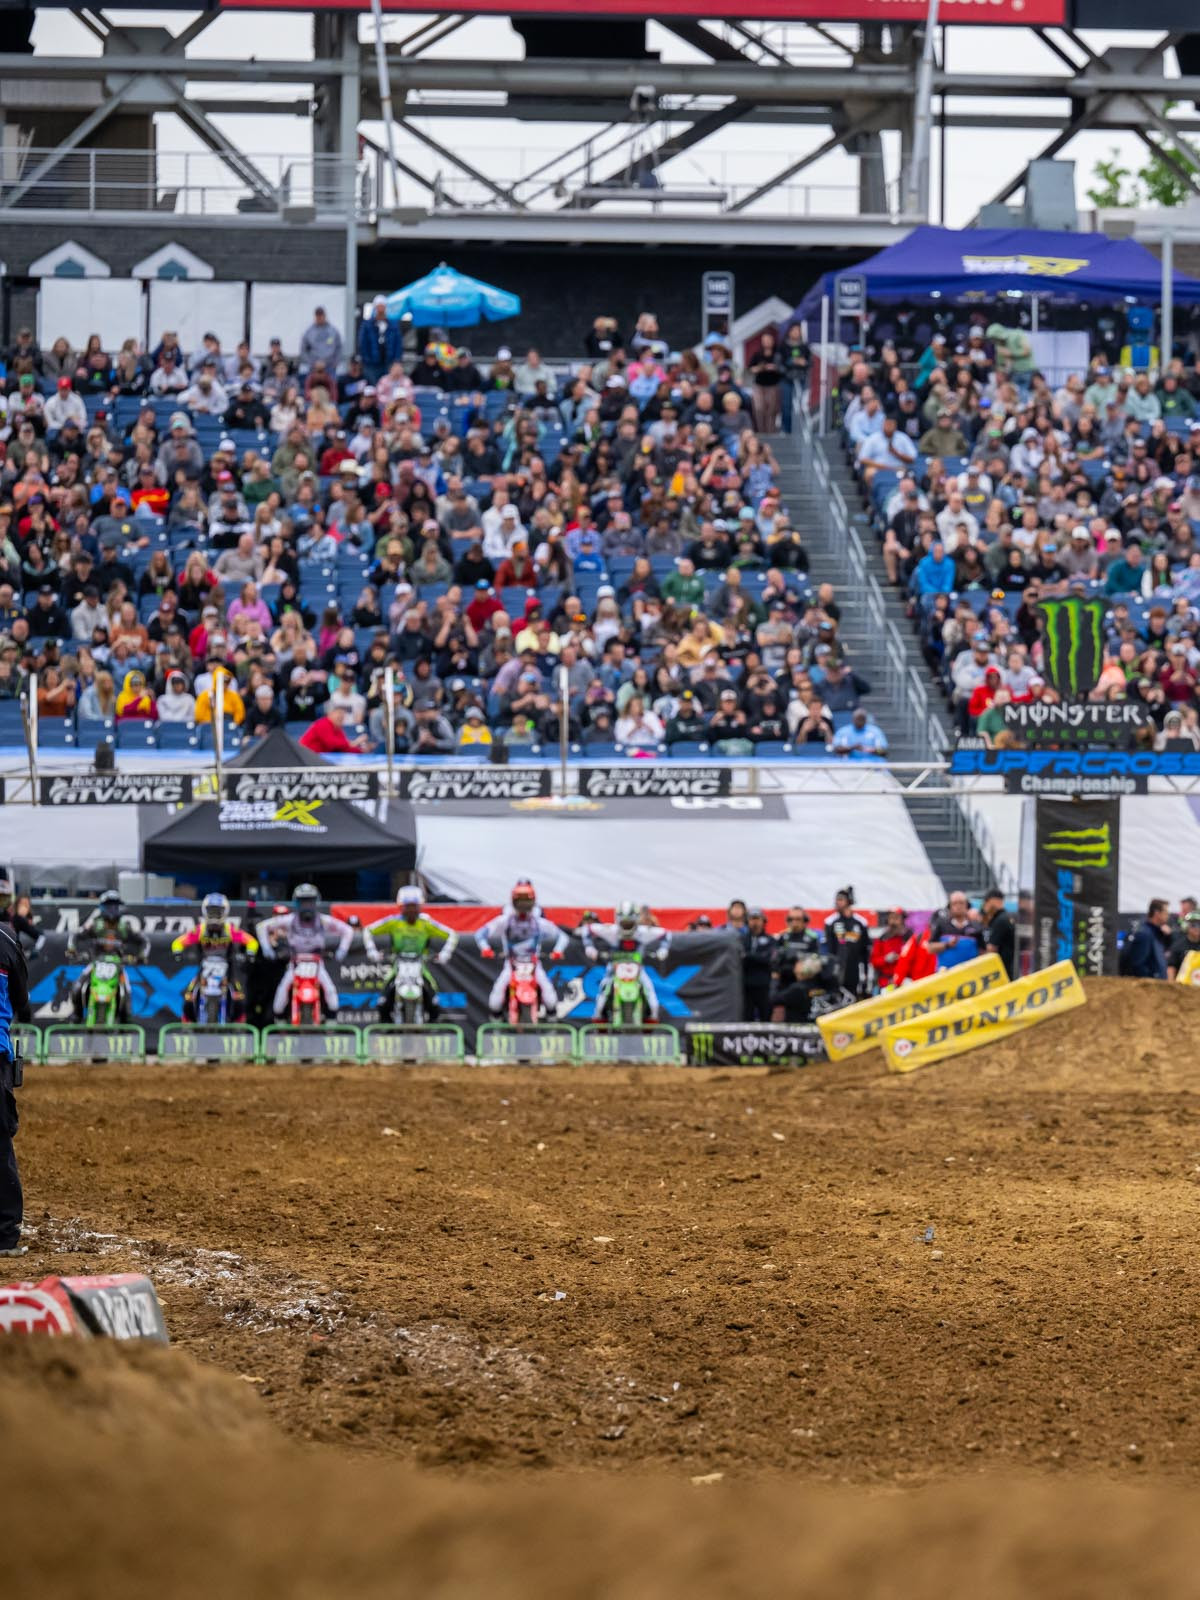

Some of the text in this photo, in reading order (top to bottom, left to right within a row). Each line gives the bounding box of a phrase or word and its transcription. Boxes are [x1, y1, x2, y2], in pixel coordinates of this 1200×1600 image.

[1003, 701, 1143, 727] MONSTER
[1025, 729, 1124, 740] ENERGY
[257, 773, 298, 785] ROCKY
[429, 770, 471, 782] ROCKY
[608, 768, 650, 780] ROCKY
[70, 775, 113, 788] ROCKY
[1020, 774, 1137, 794] Championship
[862, 971, 1001, 1039] DUNLOP
[926, 976, 1074, 1047] DUNLOP
